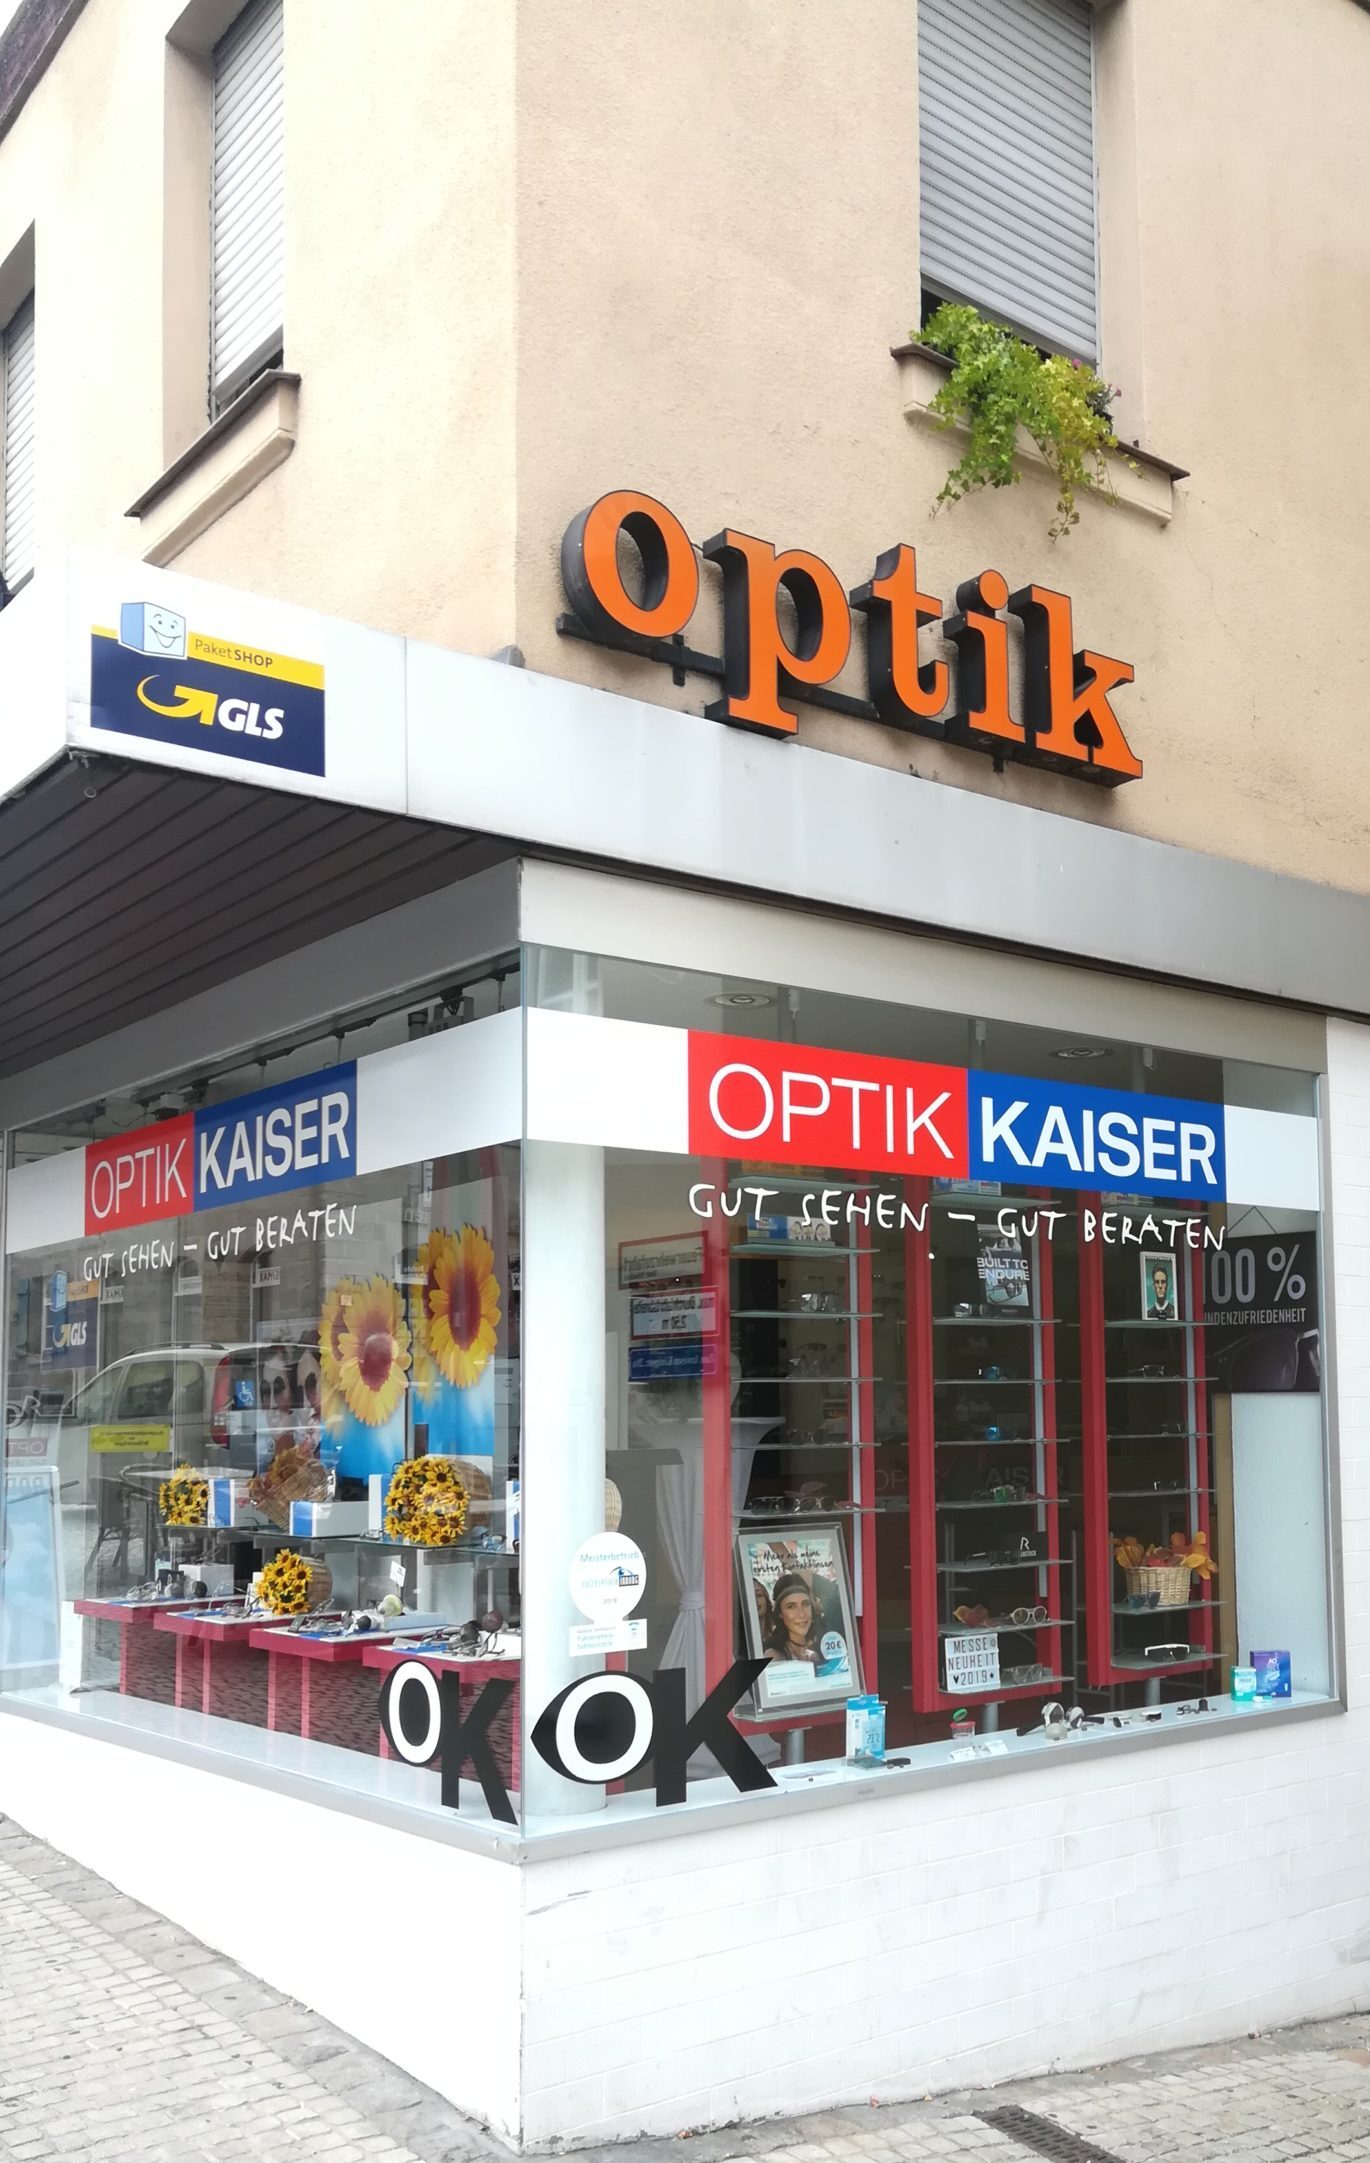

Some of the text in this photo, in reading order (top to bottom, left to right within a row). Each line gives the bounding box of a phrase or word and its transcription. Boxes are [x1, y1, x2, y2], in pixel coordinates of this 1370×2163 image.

[562, 489, 1144, 786] optik
[217, 698, 286, 740] GLS
[708, 1062, 1218, 1184] OPTIK KAISER
[90, 1090, 350, 1219] OPTIK KAISER
[688, 1182, 779, 1221] GUT
[801, 1188, 929, 1233] SEHEN
[996, 1207, 1067, 1241] GUT
[1083, 1210, 1226, 1251] BERATEN
[83, 1252, 114, 1282] GUT
[121, 1239, 175, 1277] SEHEN
[207, 1226, 247, 1260] GUT
[255, 1202, 357, 1249] BERATEN
[976, 1256, 1011, 1269] BUILT
[978, 1268, 1031, 1281] ENDURE
[1202, 1243, 1307, 1305] 00 %
[70, 1320, 88, 1346] GLS
[579, 1551, 640, 1563] Meisterbetrieb
[763, 1549, 784, 1561] Mehr
[948, 1652, 996, 1671] NEUHEIT
[953, 1637, 988, 1654] MESSE
[960, 1669, 988, 1686] 2019
[378, 1658, 519, 1826] OK
[531, 1656, 779, 1807] OK
